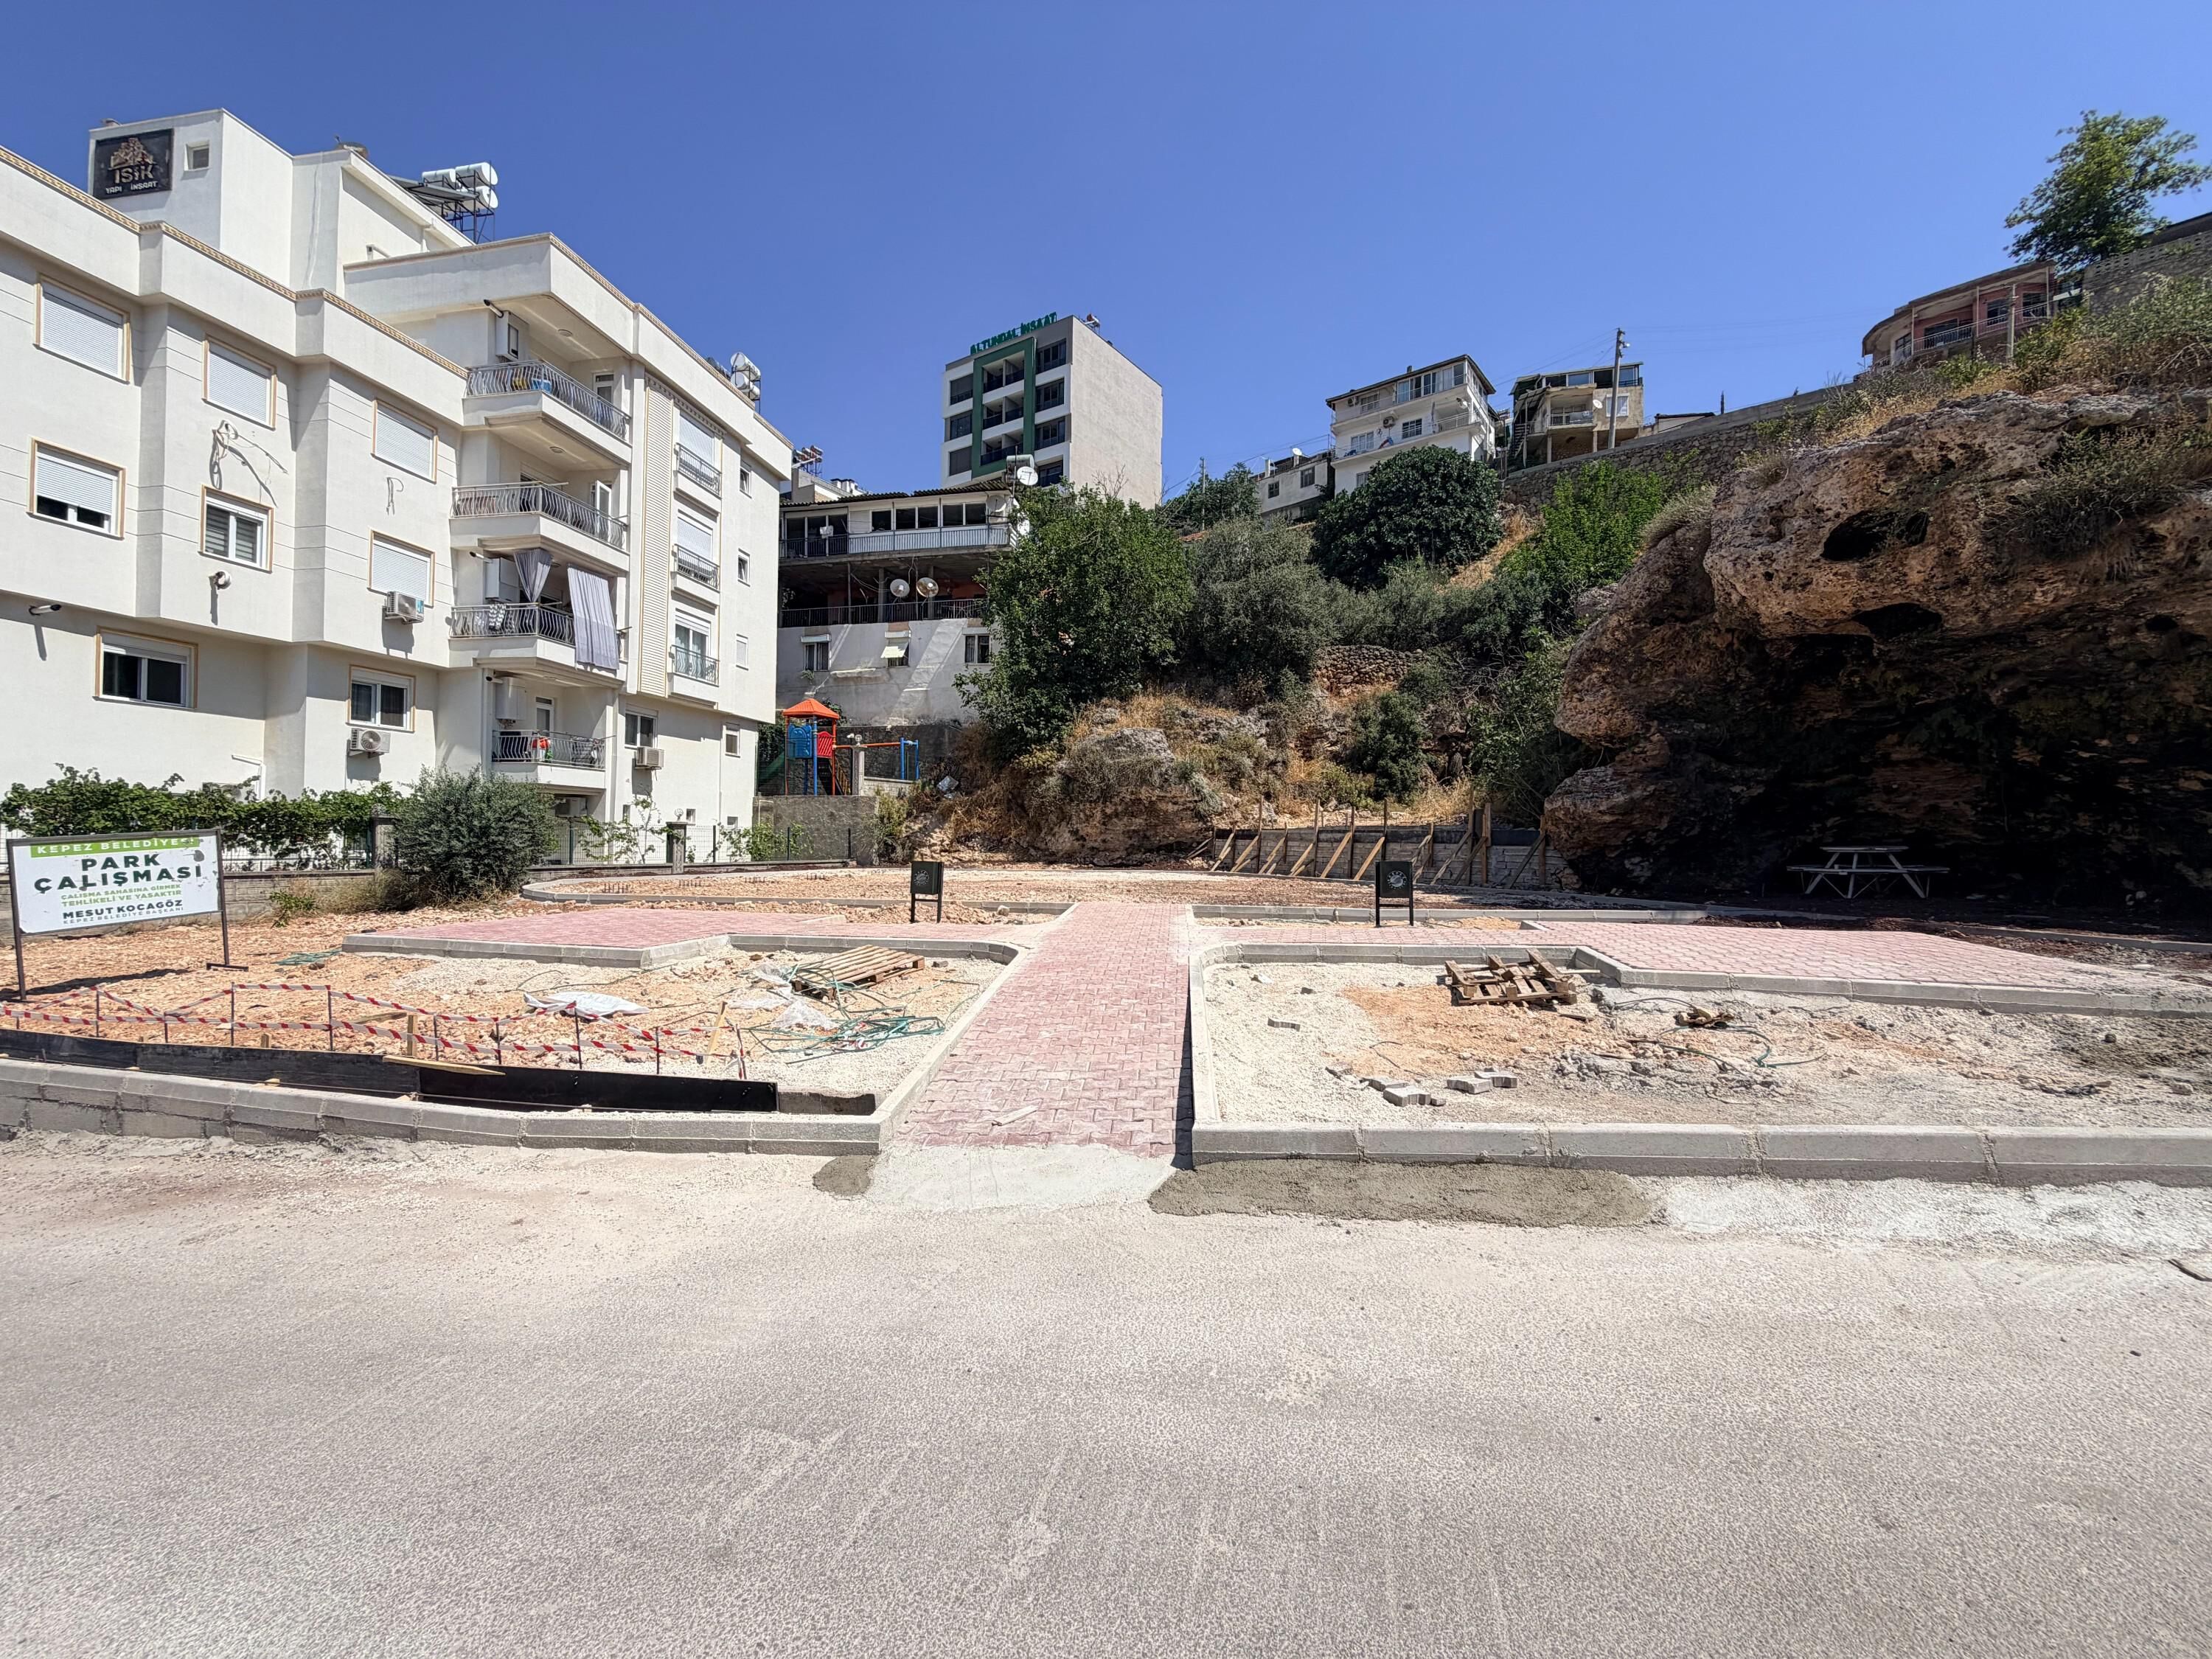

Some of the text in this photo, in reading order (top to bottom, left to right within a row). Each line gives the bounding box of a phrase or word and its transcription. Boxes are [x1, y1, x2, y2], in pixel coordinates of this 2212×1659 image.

[38, 843, 92, 854] KEPEZ
[81, 853, 160, 872] PARK
[104, 887, 149, 895] SAHASINA
[135, 890, 181, 899] YASAKTIR
[63, 900, 183, 919] MESUT KOCAGÖZ
